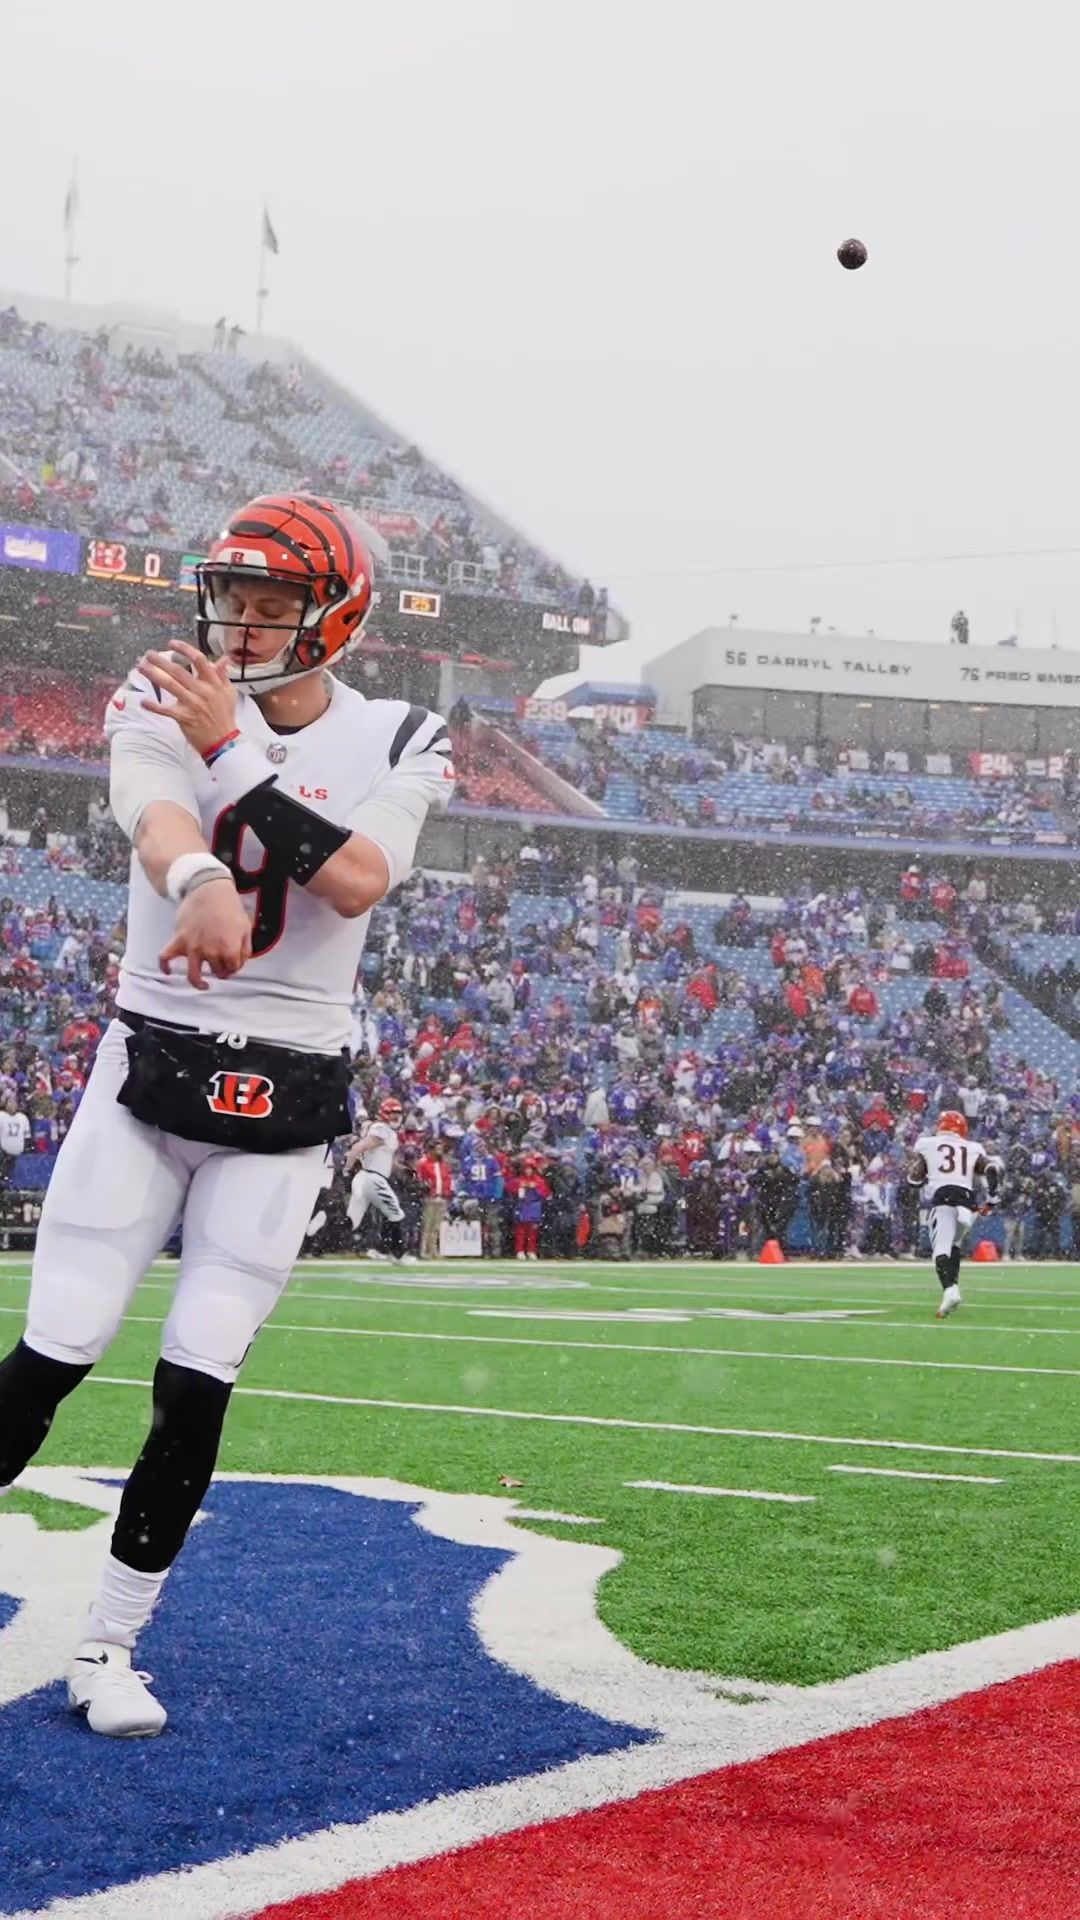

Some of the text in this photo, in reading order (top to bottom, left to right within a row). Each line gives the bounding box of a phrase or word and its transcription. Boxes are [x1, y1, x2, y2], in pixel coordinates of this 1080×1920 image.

[144, 552, 161, 577] 0
[542, 612, 571, 632] BALL
[725, 650, 912, 675] 56 DARRYL TALLEY
[985, 670, 1032, 681] FRED
[936, 1144, 968, 1176] 31
[471, 1164, 487, 1180] 91
